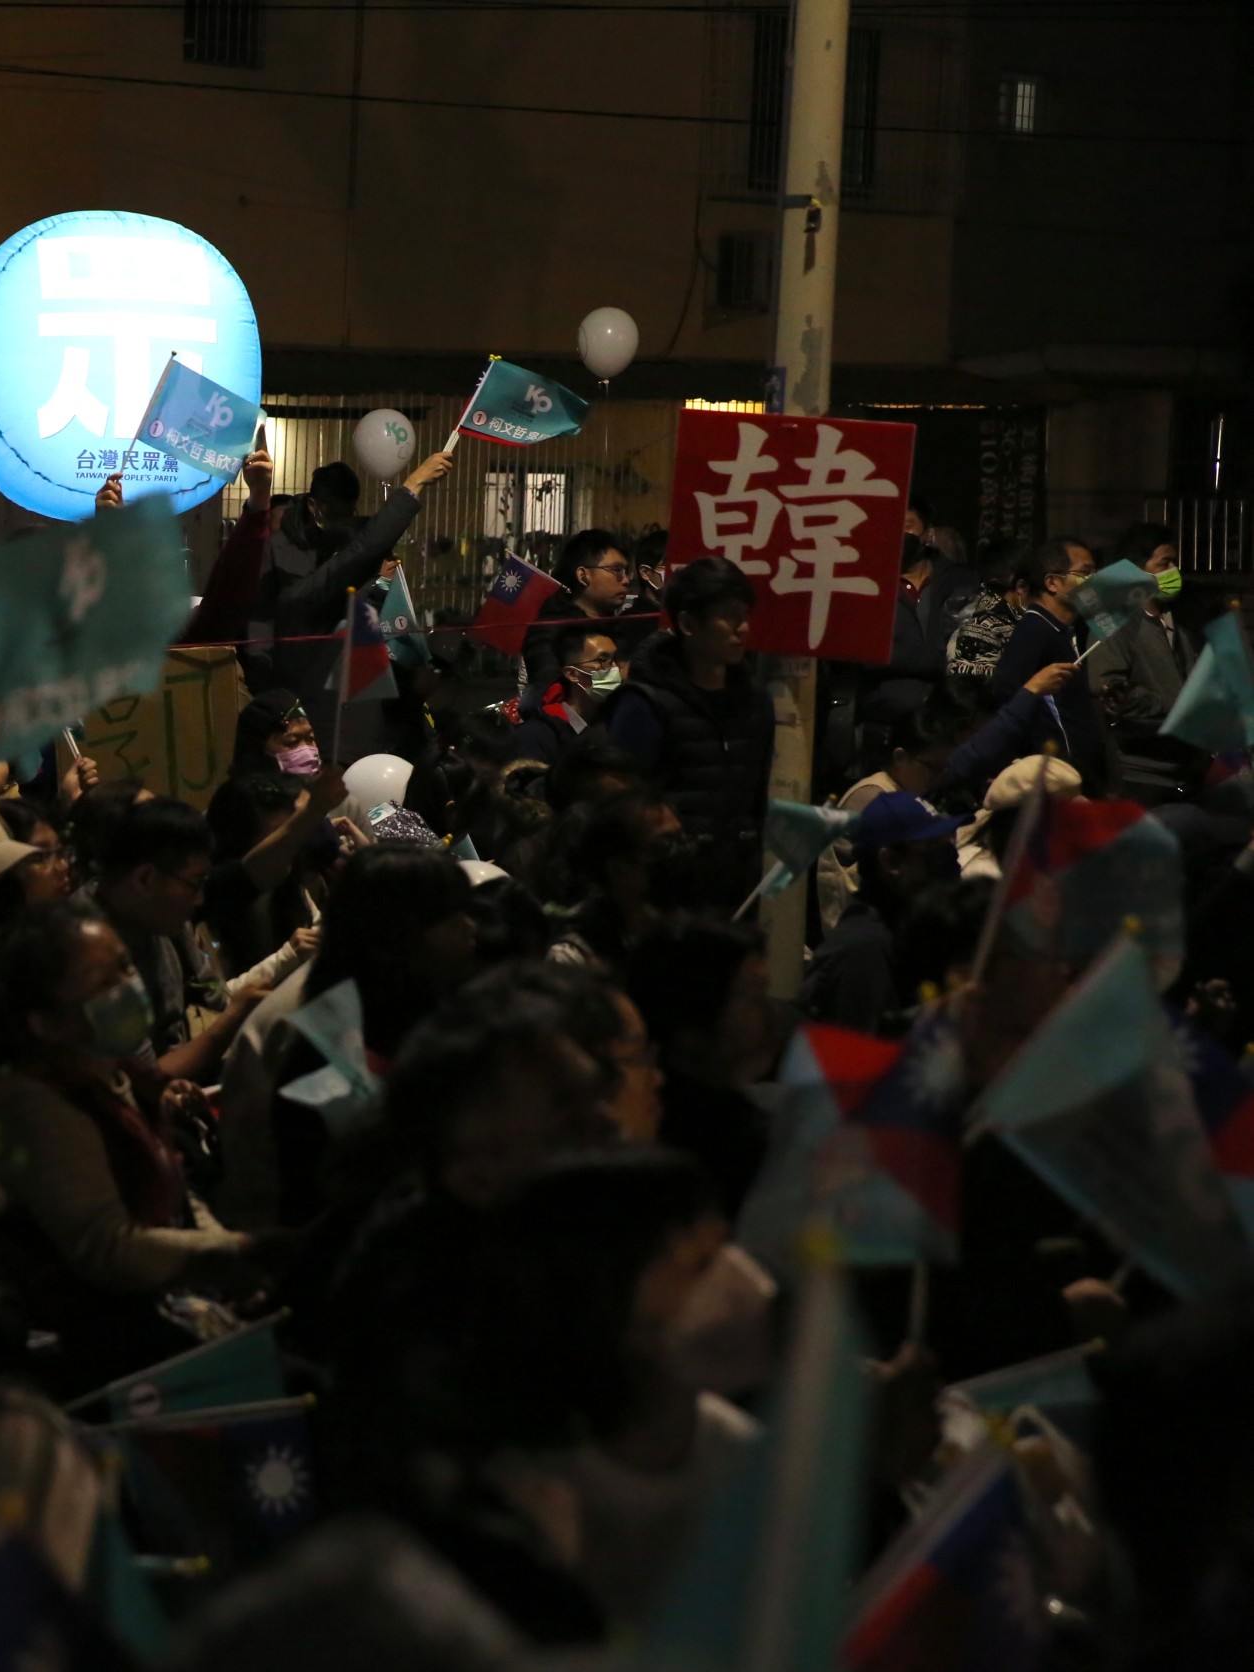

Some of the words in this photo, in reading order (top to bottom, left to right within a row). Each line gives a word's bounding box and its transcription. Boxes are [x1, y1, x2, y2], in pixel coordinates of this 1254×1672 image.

[37, 235, 218, 440] 眾
[76, 449, 180, 473] 台灣民眾黨
[671, 421, 900, 650] 韓
